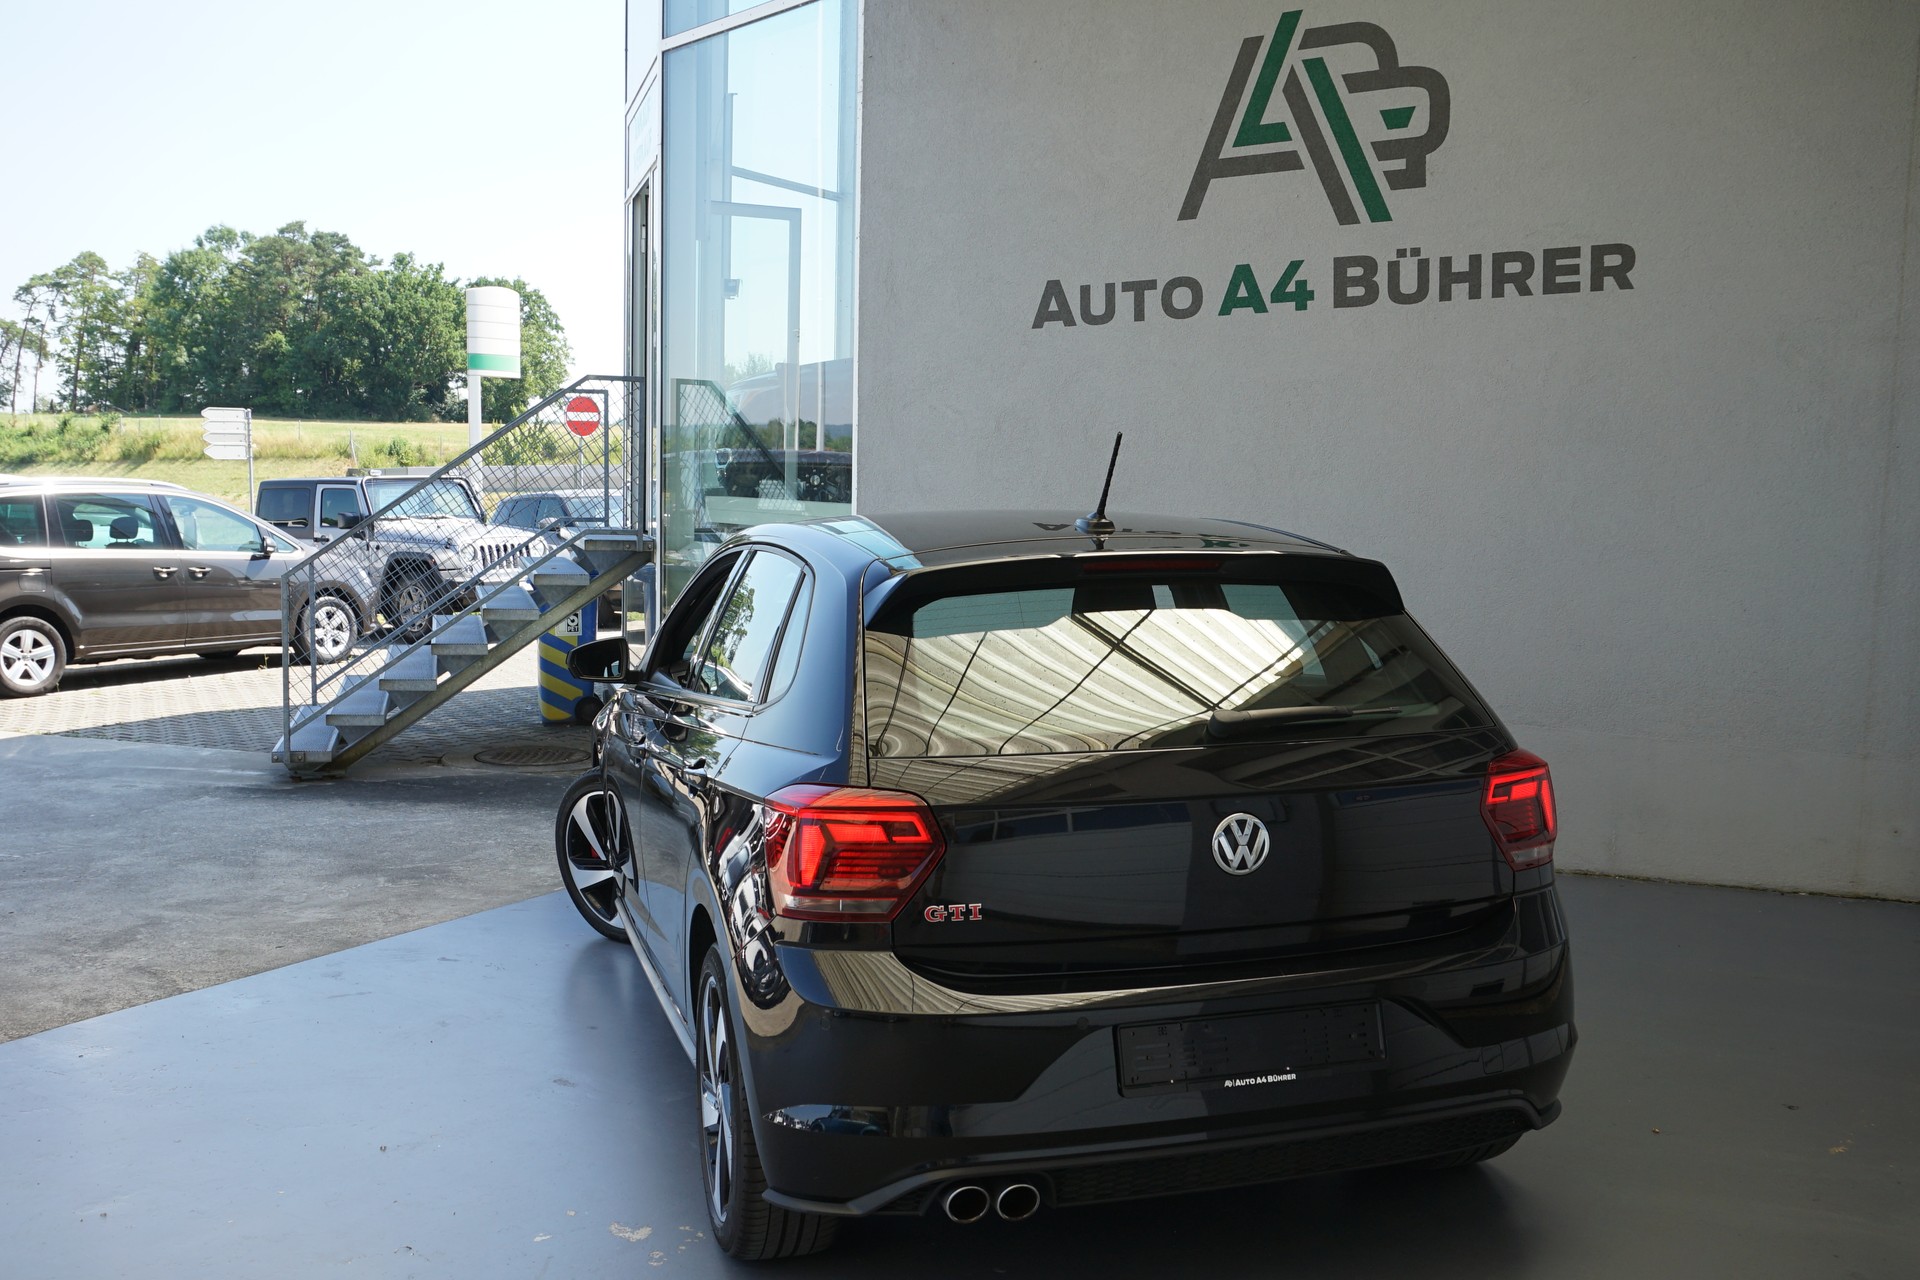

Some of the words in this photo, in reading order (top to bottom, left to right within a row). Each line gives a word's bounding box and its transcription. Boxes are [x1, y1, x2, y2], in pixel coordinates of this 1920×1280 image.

[1031, 276, 1204, 330] AUTO
[1217, 259, 1315, 317] A4
[1333, 243, 1637, 309] BÜHRER
[924, 903, 982, 922] GTI
[1235, 1078, 1256, 1087] AUTO
[1256, 1076, 1267, 1084] A4
